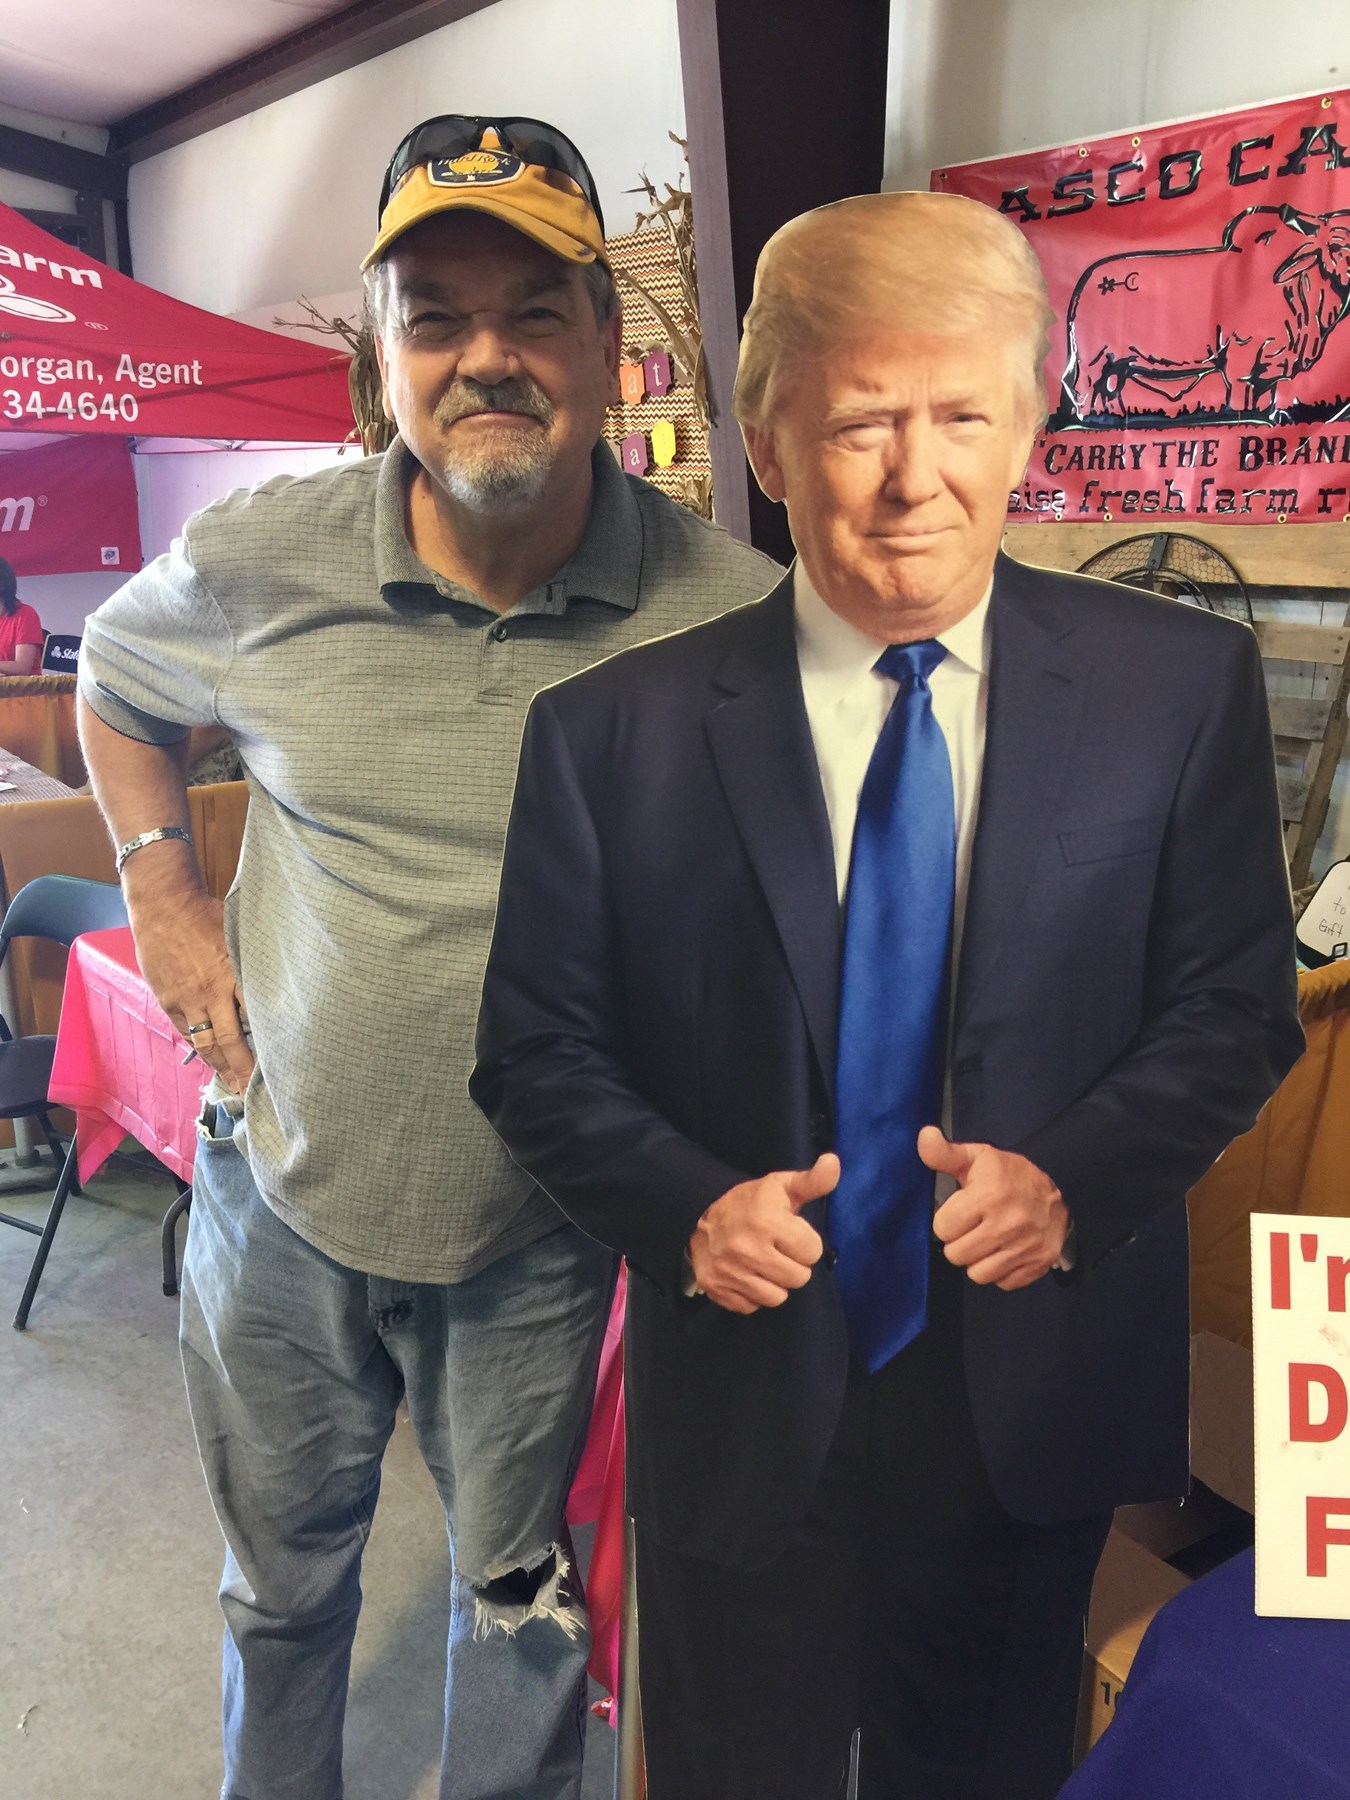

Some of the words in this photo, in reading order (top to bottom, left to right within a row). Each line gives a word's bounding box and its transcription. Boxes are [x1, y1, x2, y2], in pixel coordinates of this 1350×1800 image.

[1227, 122, 1350, 187] CA
[0, 355, 104, 385] organ,
[115, 353, 203, 389] Agent
[2, 388, 139, 423] 34-4640
[1152, 438, 1220, 468] THE
[1078, 479, 1186, 514] fresh
[1196, 477, 1300, 515] farm
[1318, 918, 1344, 938] Gift
